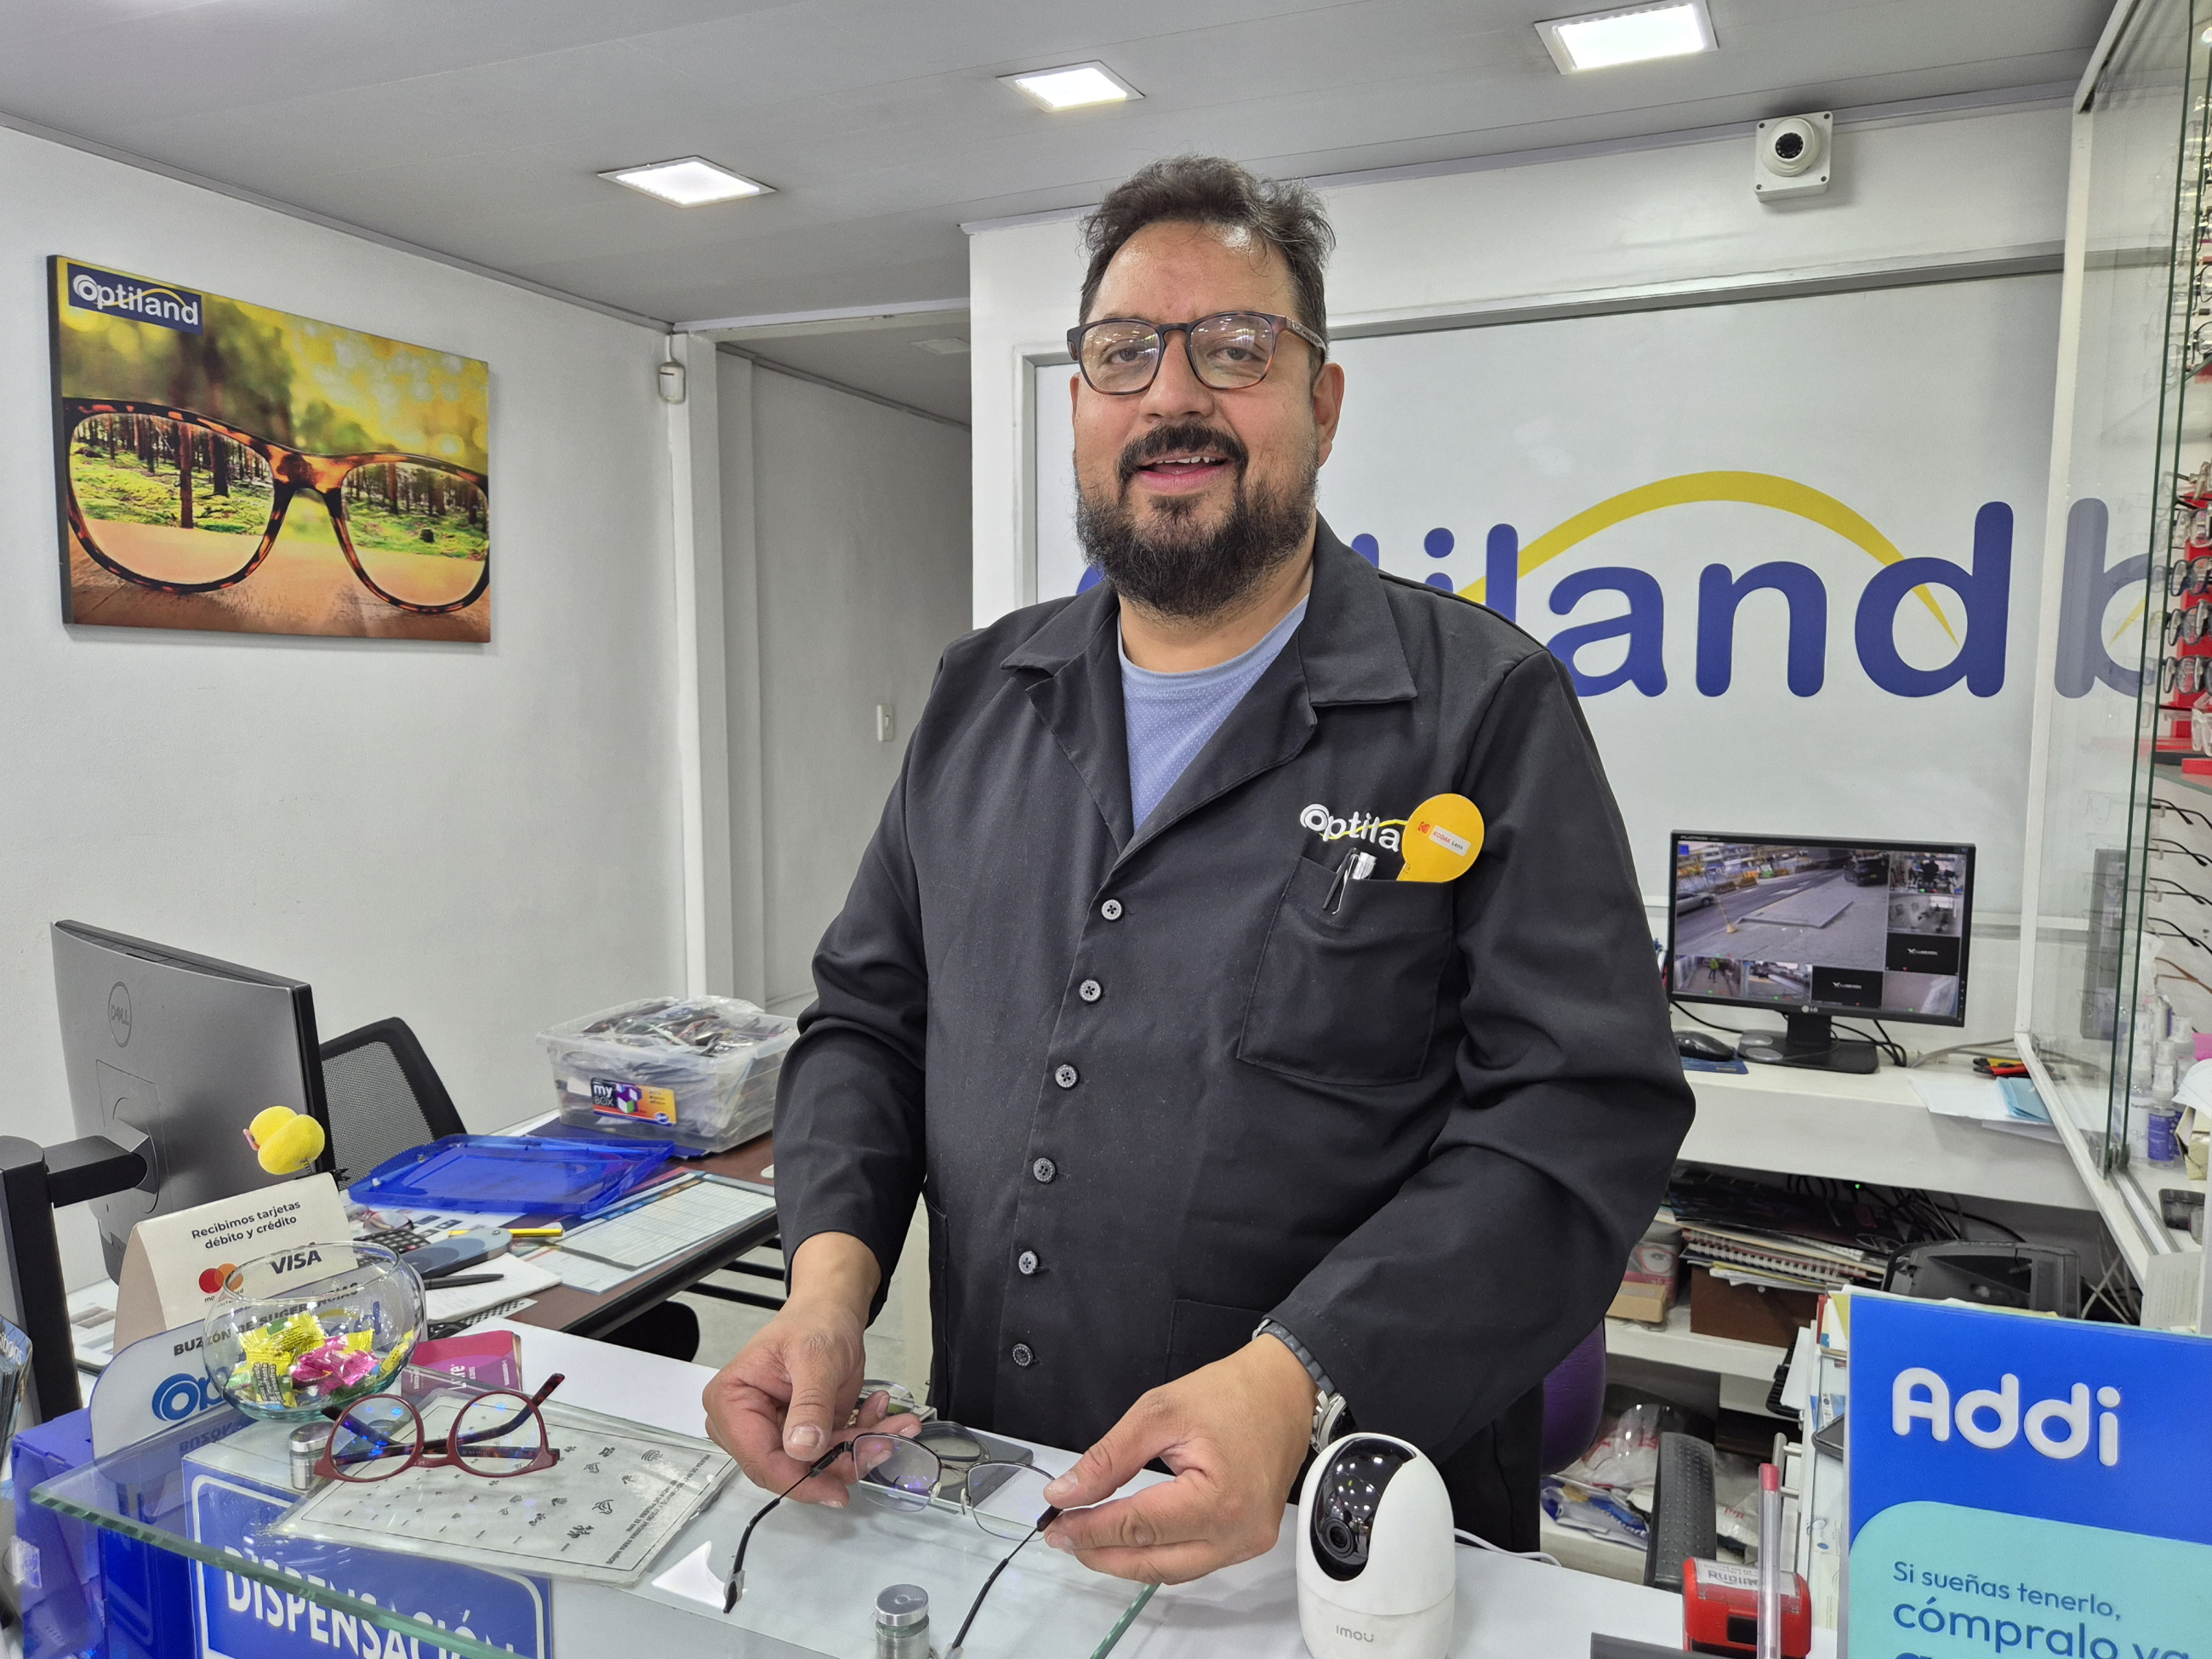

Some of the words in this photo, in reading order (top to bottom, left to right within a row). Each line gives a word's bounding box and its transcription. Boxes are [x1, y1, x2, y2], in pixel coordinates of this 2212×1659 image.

[73, 275, 198, 326] Optiland
[1300, 804, 1400, 852] Optila
[1433, 830, 1451, 844] KODAK
[1451, 839, 1463, 851] Lens
[111, 1003, 129, 1026] DELL
[593, 1085, 613, 1097] my
[595, 1096, 614, 1107] BOX
[191, 1214, 254, 1239] Recibimos
[257, 1201, 301, 1220] tarjetas
[205, 1231, 244, 1249] débito
[246, 1229, 254, 1239] y
[256, 1215, 297, 1234] crédito
[271, 1250, 322, 1274] VISA
[1892, 1366, 2121, 1467] Addi
[1893, 1560, 1914, 1583] Si
[1921, 1571, 2010, 1599] sueñas
[2016, 1582, 2122, 1622] tenerlo,
[1893, 1596, 2118, 1659] cómpralo
